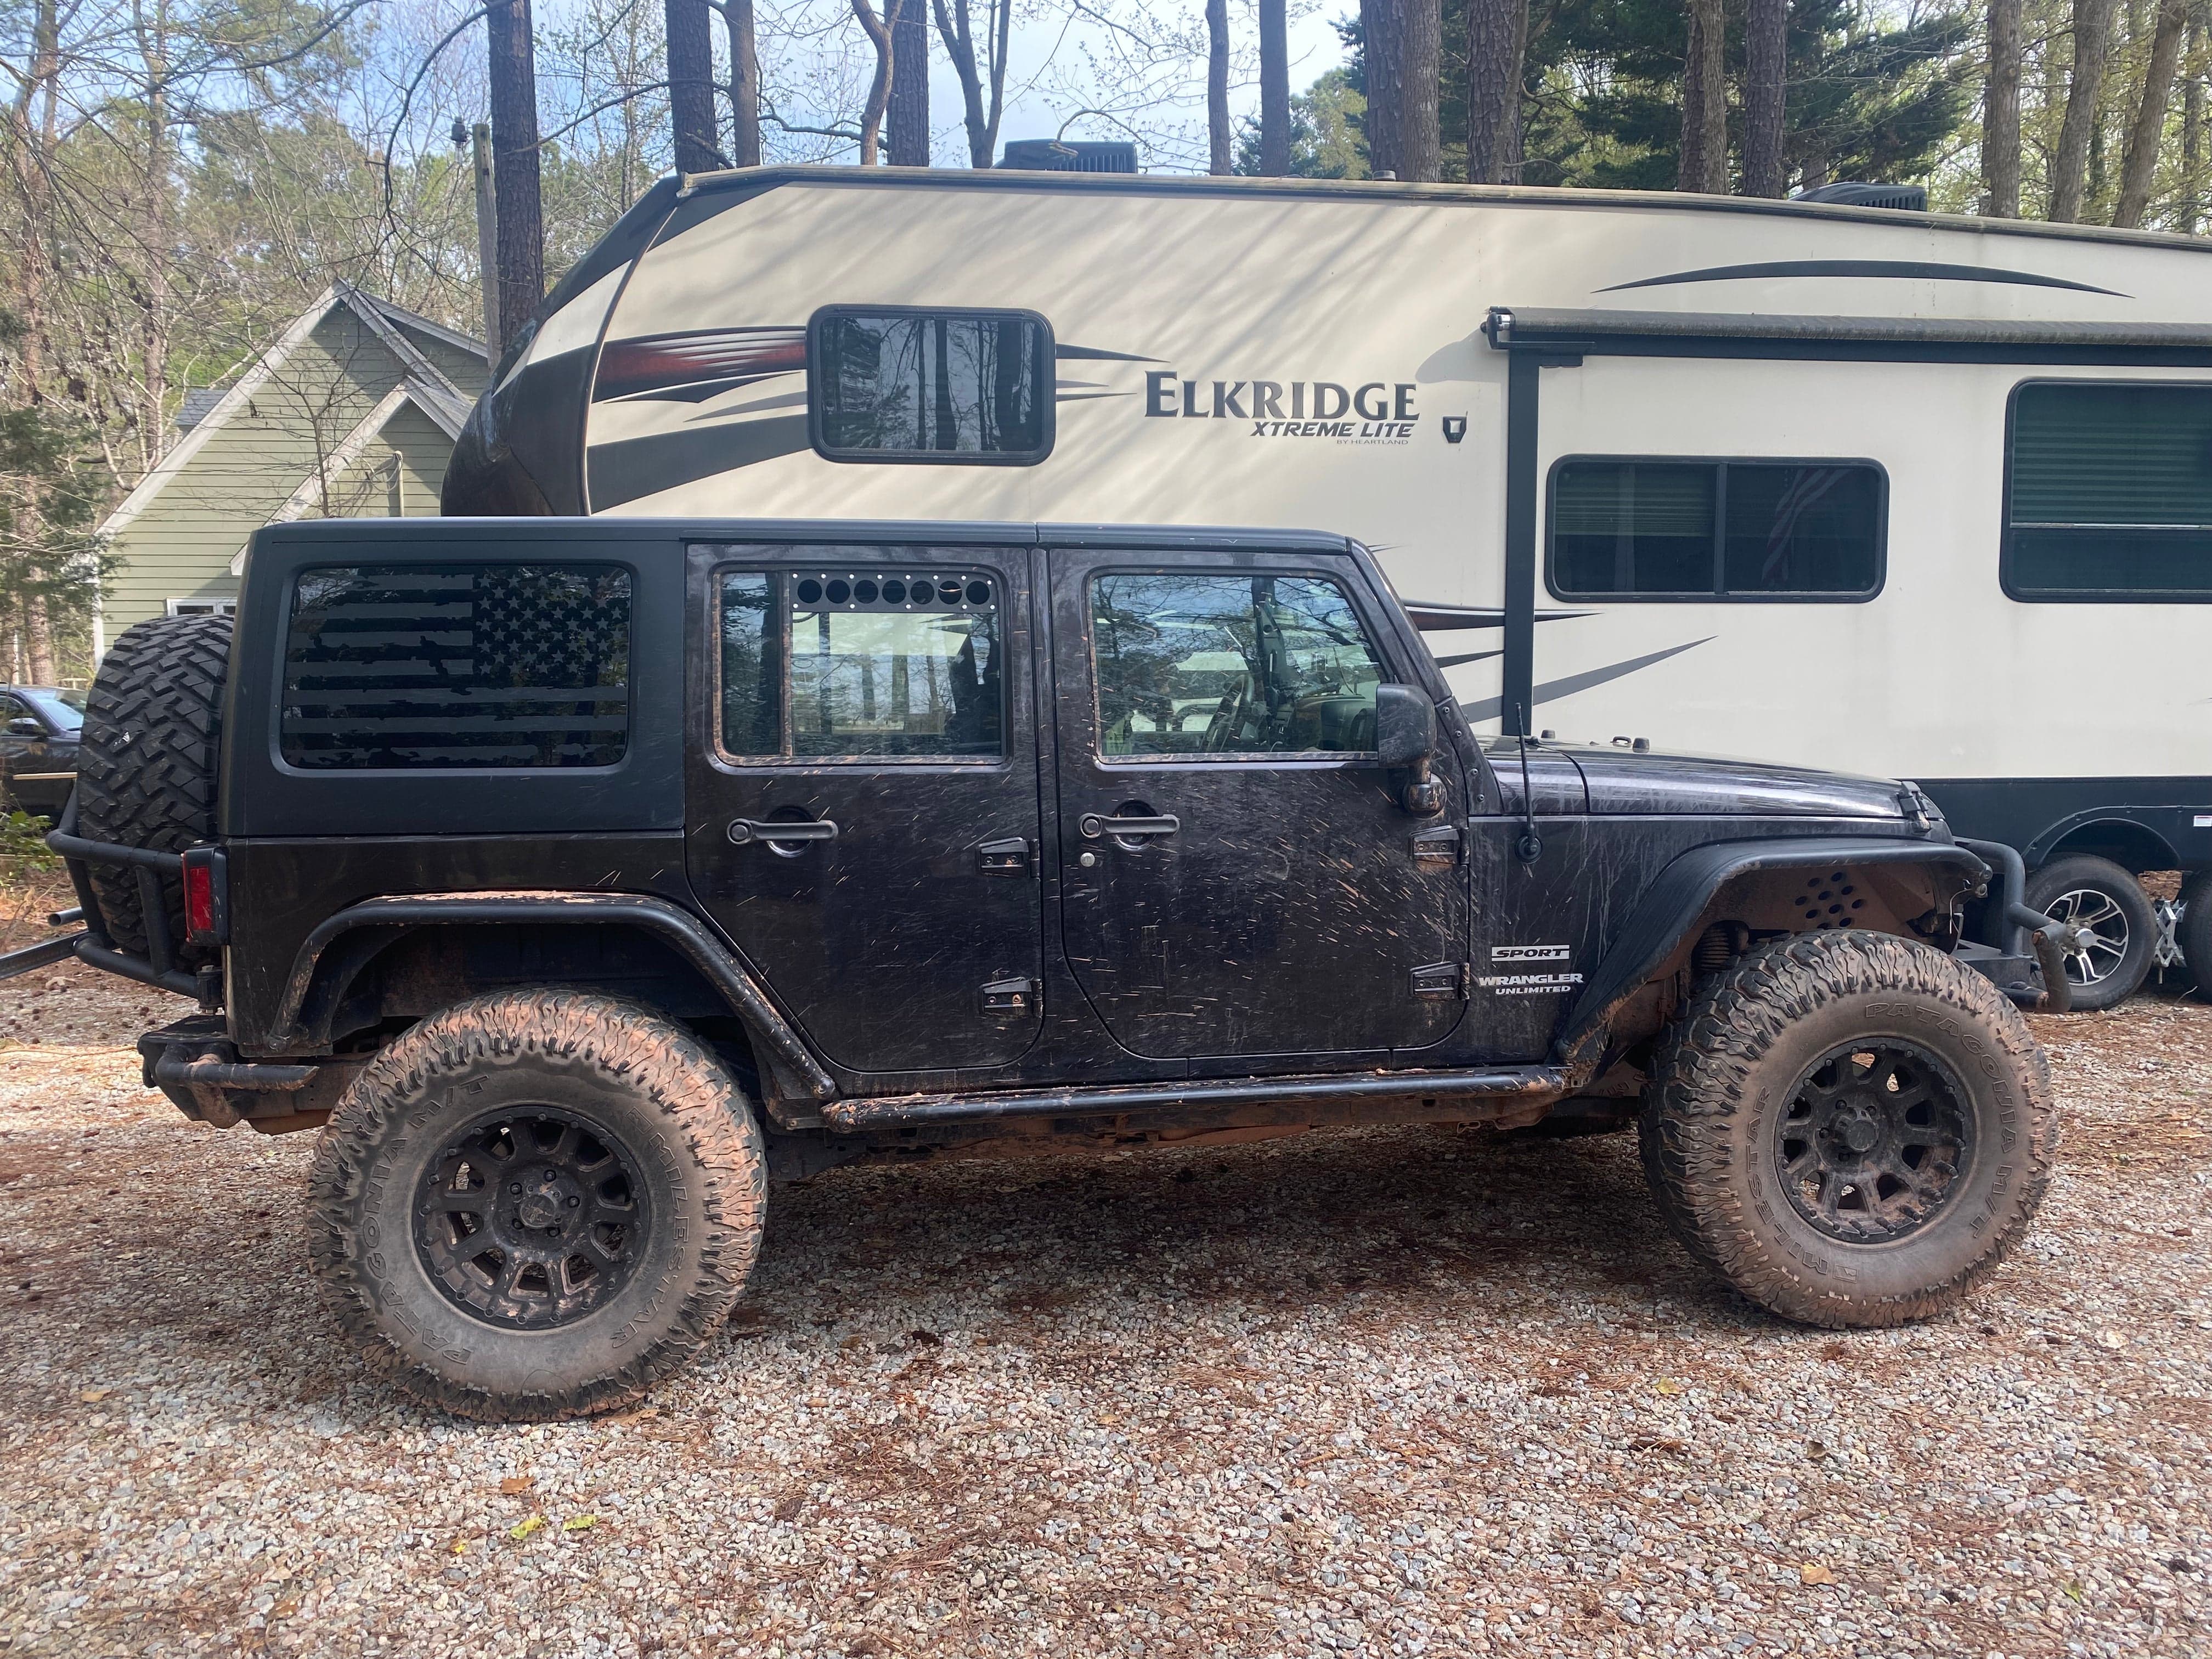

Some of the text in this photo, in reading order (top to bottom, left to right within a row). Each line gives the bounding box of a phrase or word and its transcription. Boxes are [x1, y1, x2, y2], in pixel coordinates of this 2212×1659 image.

[1144, 370, 1420, 421] ELKRIDGE
[1250, 421, 1416, 438] XTREME LITE
[1493, 947, 1570, 958] SPORT
[1479, 973, 1584, 986] WRANGLER
[1495, 985, 1571, 995] UNLIMITED
[1865, 1002, 2017, 1239] PATAGONIA M/T
[1746, 1086, 1829, 1276] MILESTAR
[363, 1074, 490, 1364] PATAGONIA M/T
[610, 1132, 689, 1348] MILESTAR
